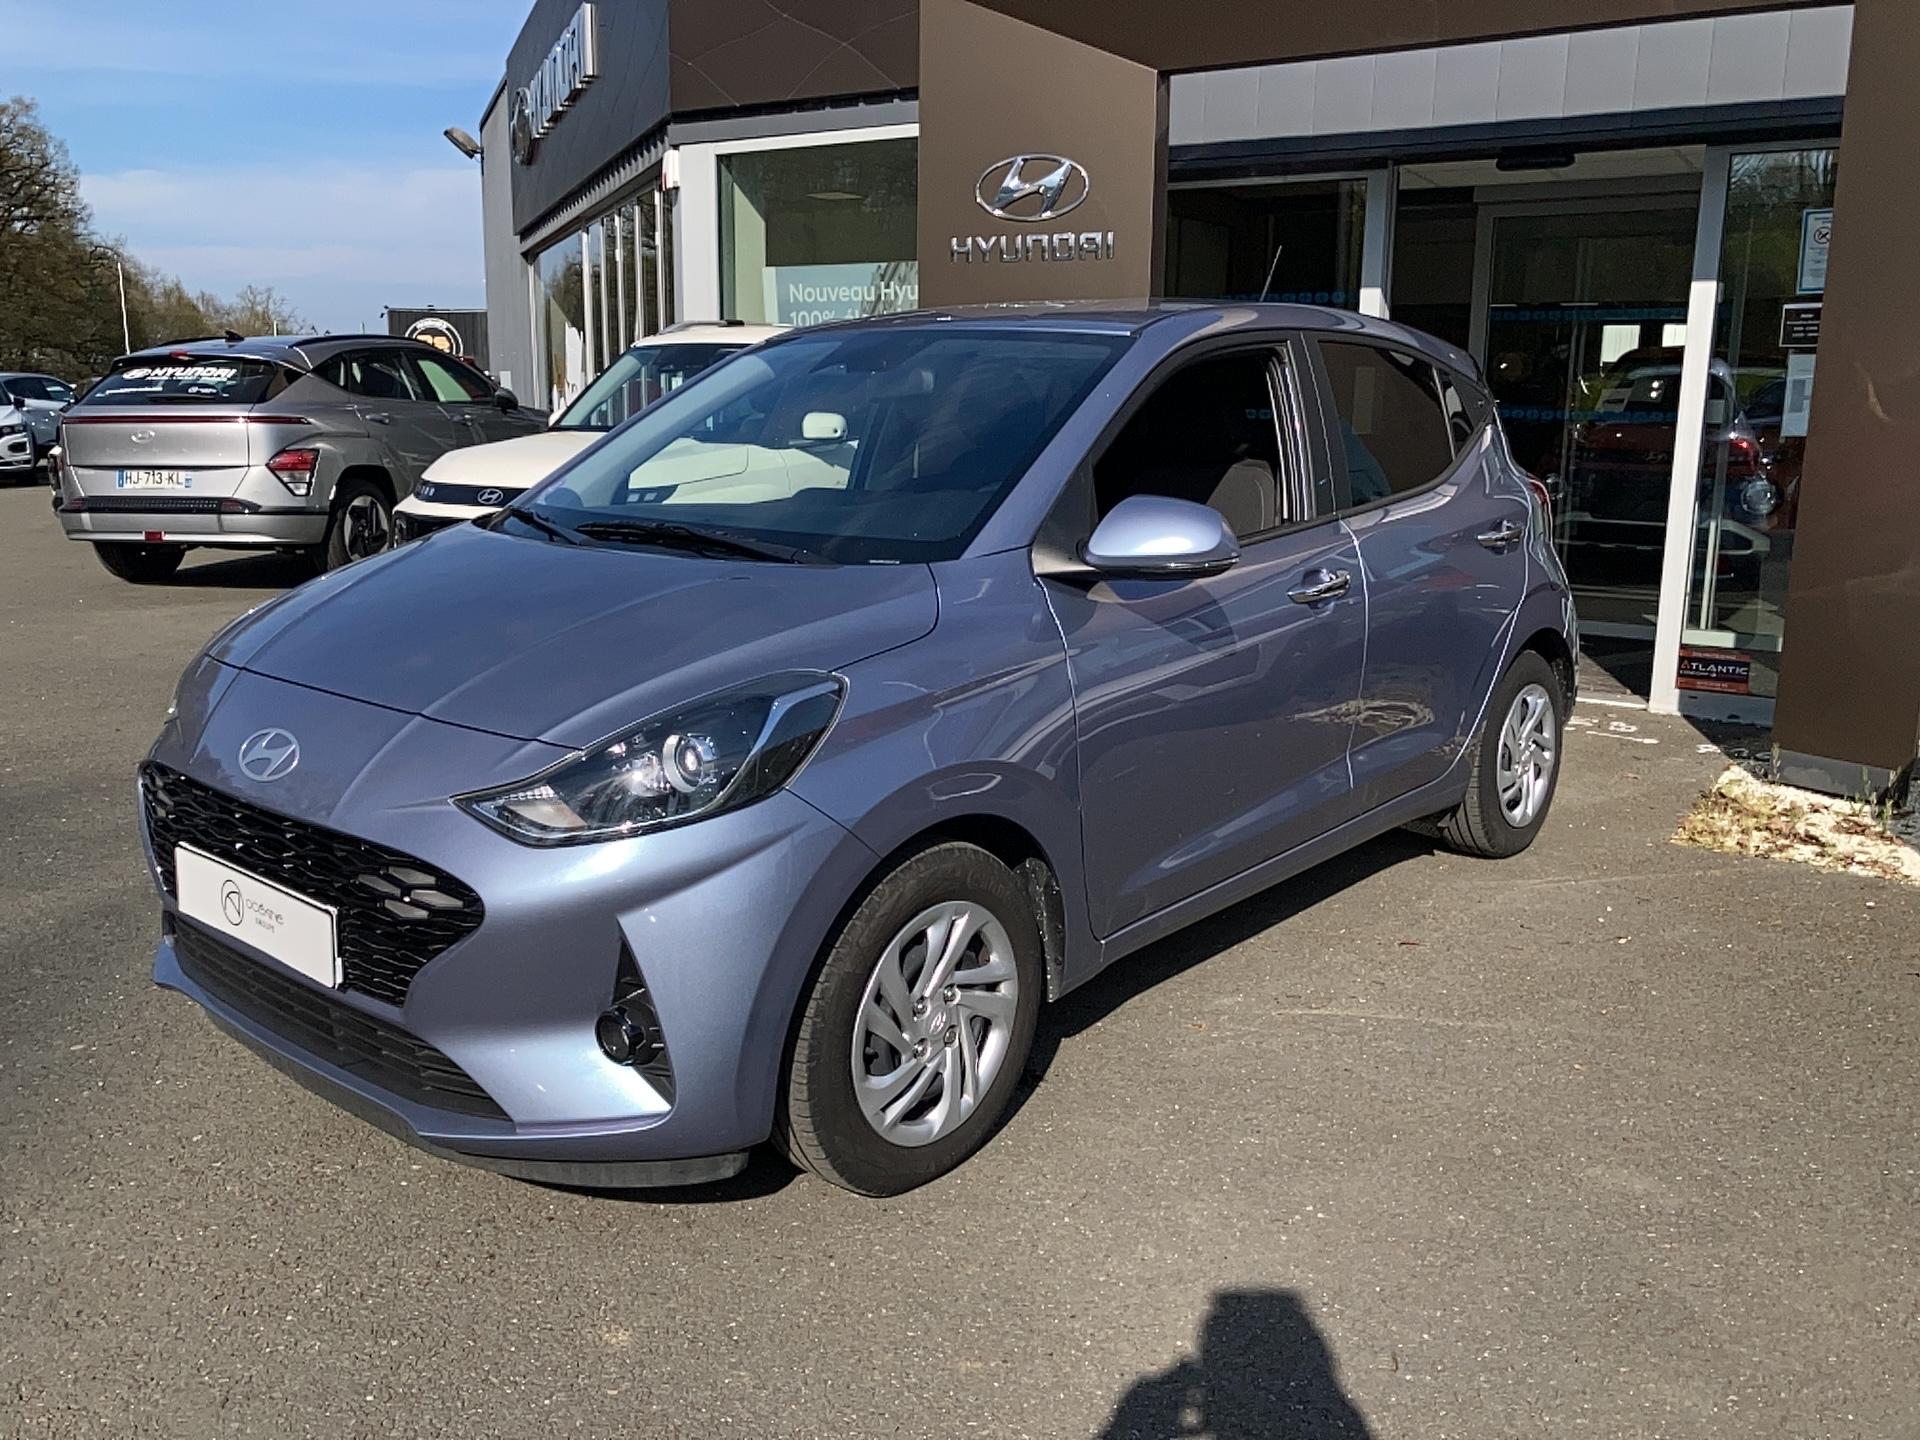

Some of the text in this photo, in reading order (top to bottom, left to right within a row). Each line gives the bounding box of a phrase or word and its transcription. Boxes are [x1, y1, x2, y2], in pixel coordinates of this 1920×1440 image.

[950, 231, 1115, 264] HYUNDAI
[789, 283, 876, 303] Nouveau
[150, 366, 237, 379] HYUNDAI
[1680, 660, 1748, 675] ATLANTIC
